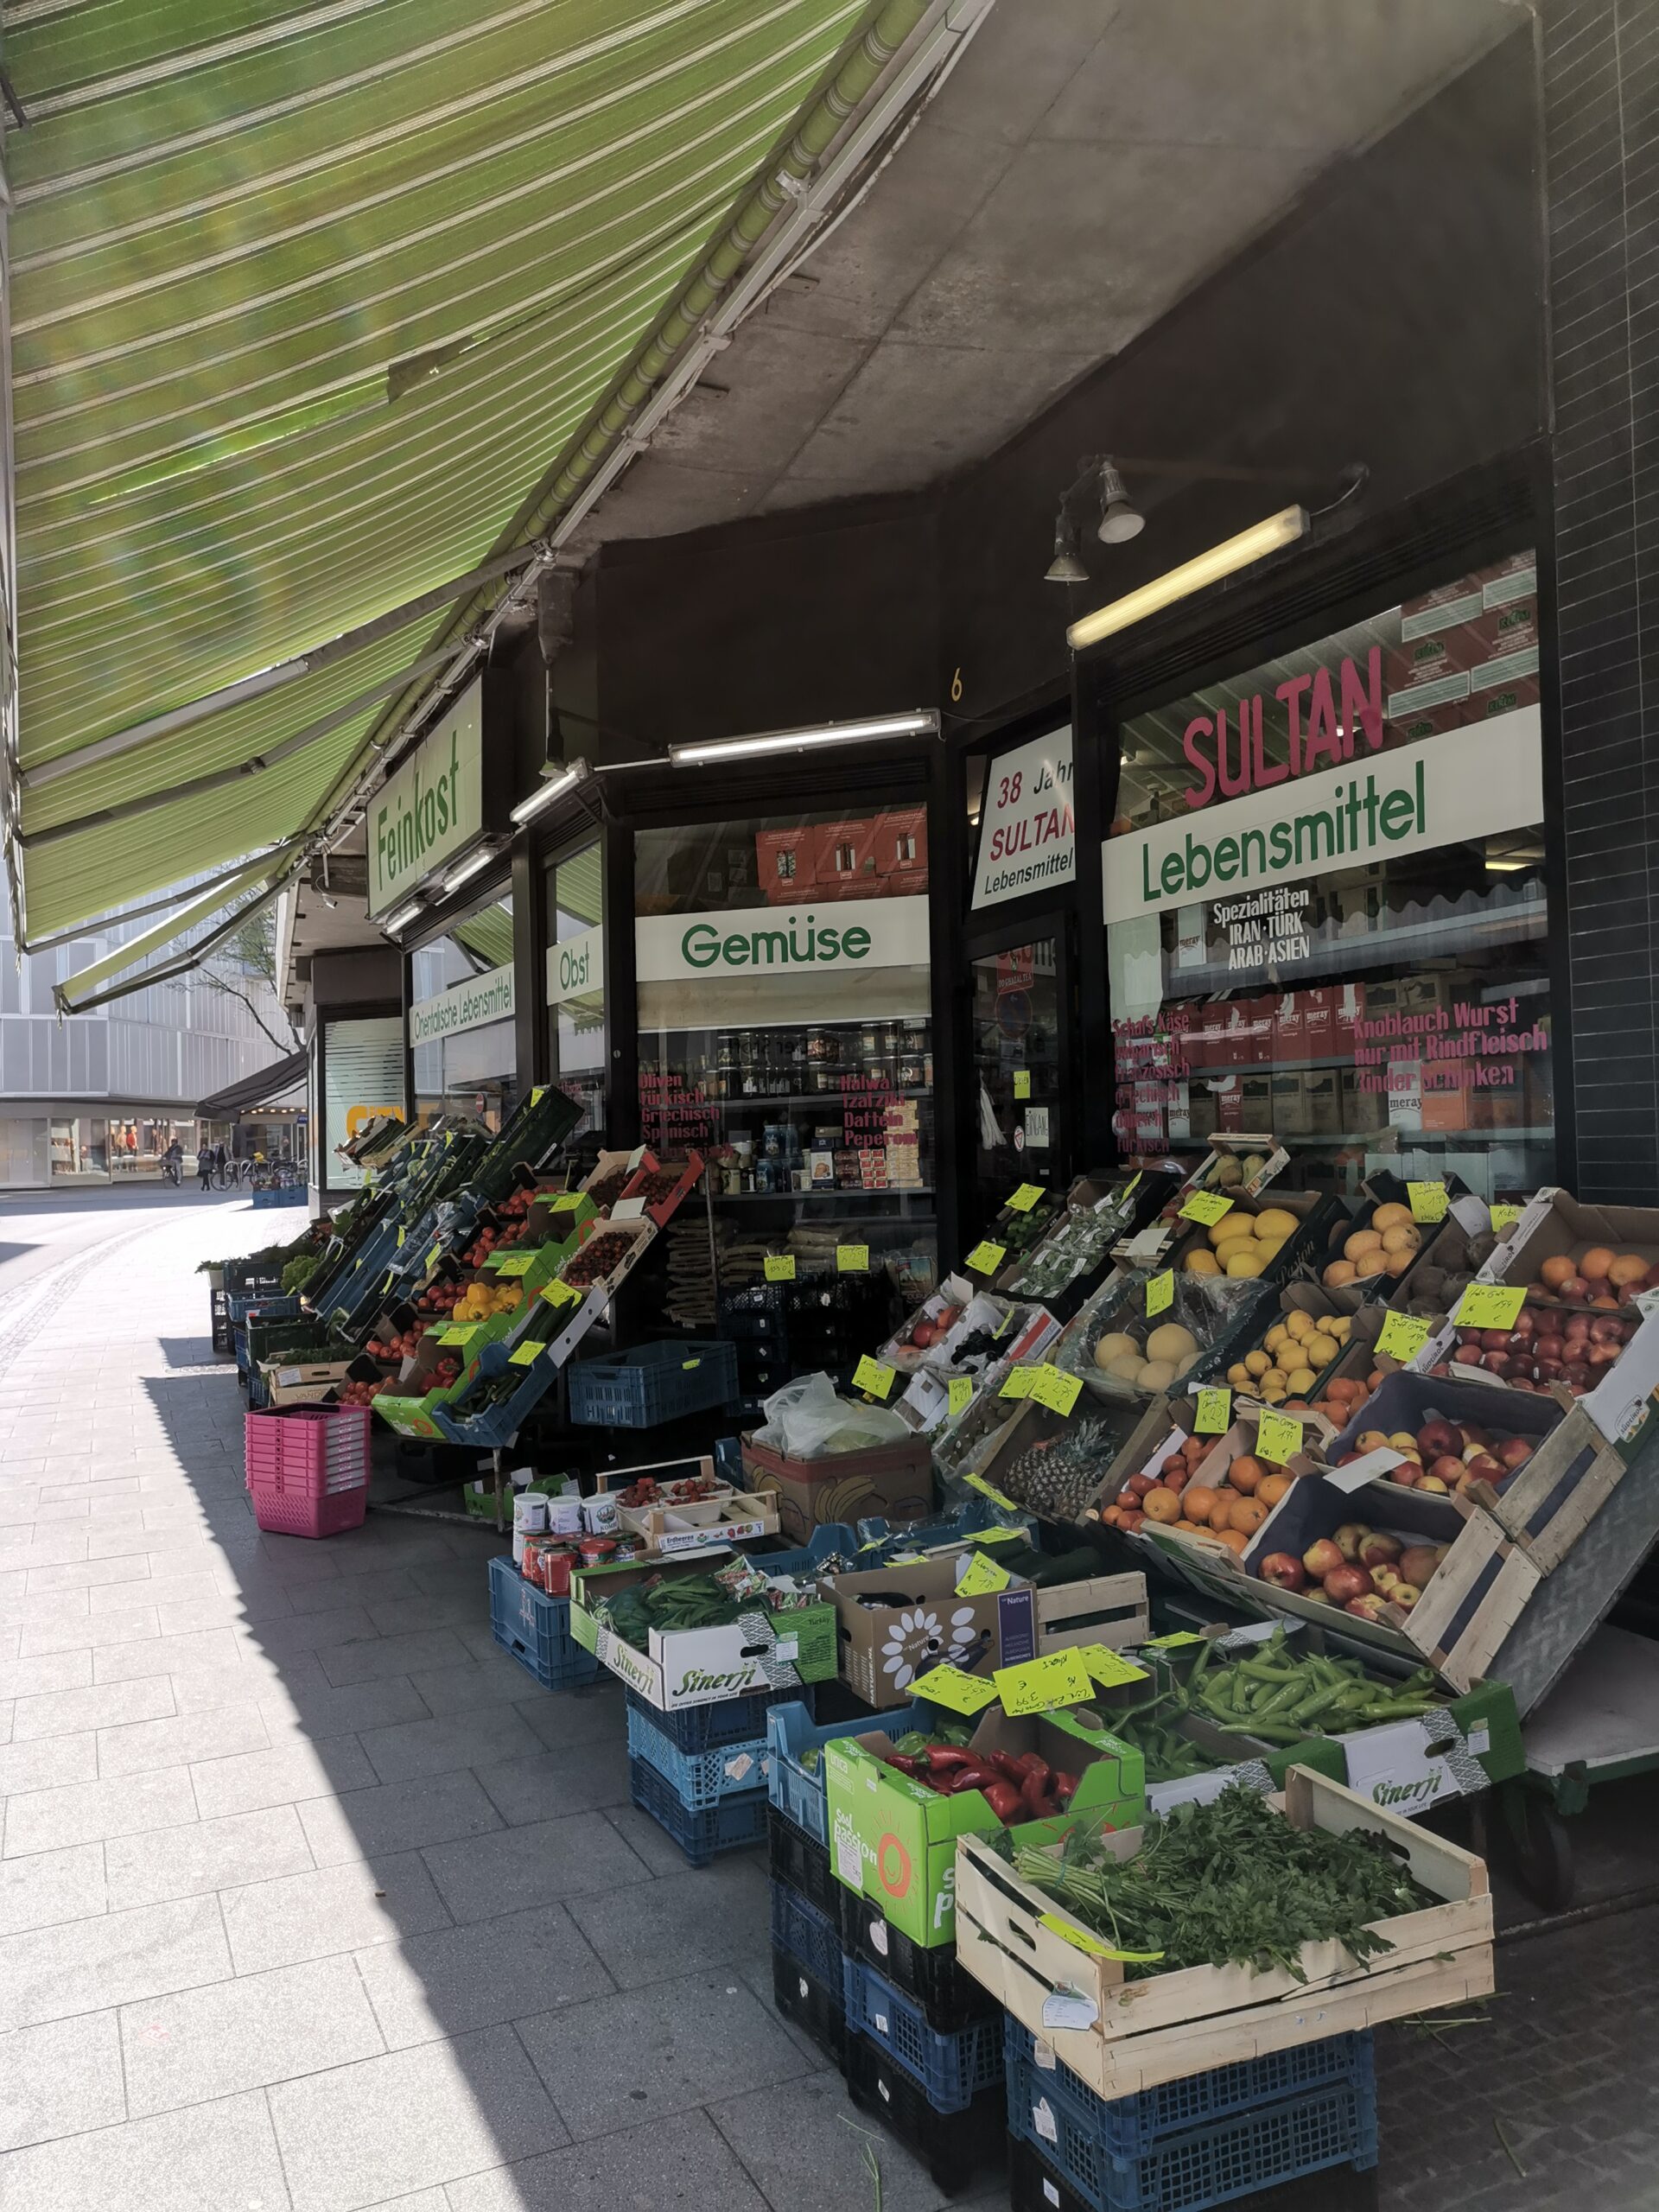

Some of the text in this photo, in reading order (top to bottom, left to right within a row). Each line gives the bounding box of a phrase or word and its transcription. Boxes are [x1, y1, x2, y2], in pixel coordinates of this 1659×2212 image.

[951, 667, 962, 702] 6
[1184, 645, 1382, 808] SULTAN
[997, 772, 1022, 809] 38
[378, 730, 460, 892] Feinkost
[990, 803, 1074, 861] SULTAN
[1143, 760, 1426, 901] Lebensmittel
[985, 848, 1073, 894] Lebensmittel
[1213, 887, 1309, 928] Spezialitäten
[681, 914, 872, 968] Gemüse
[560, 942, 589, 990] Obst
[415, 973, 512, 1041] Orientalische Lebensmittel
[1112, 1011, 1190, 1036] Schafs Käse
[1354, 997, 1519, 1039] Knoblauch Wurst
[1355, 1024, 1548, 1067] nur mit Rindfleisch
[639, 1074, 682, 1089] Oliven
[840, 1074, 890, 1091] Halwa
[641, 1106, 720, 1123] Griechisch
[842, 1091, 906, 1109] Tzatziki
[1169, 1109, 1190, 1120] meray
[1389, 1096, 1422, 1109] meray
[643, 1122, 709, 1142] Spanisch
[844, 1110, 904, 1128] Datteln
[844, 1128, 918, 1148] Peperoni
[666, 1535, 694, 1544] Erdbeeren
[1007, 1595, 1029, 1605] Nature
[908, 1635, 930, 1651] Nature
[613, 1643, 656, 1695] Sinerji
[671, 1661, 759, 1697] Sinerji
[834, 1819, 878, 1866] passion
